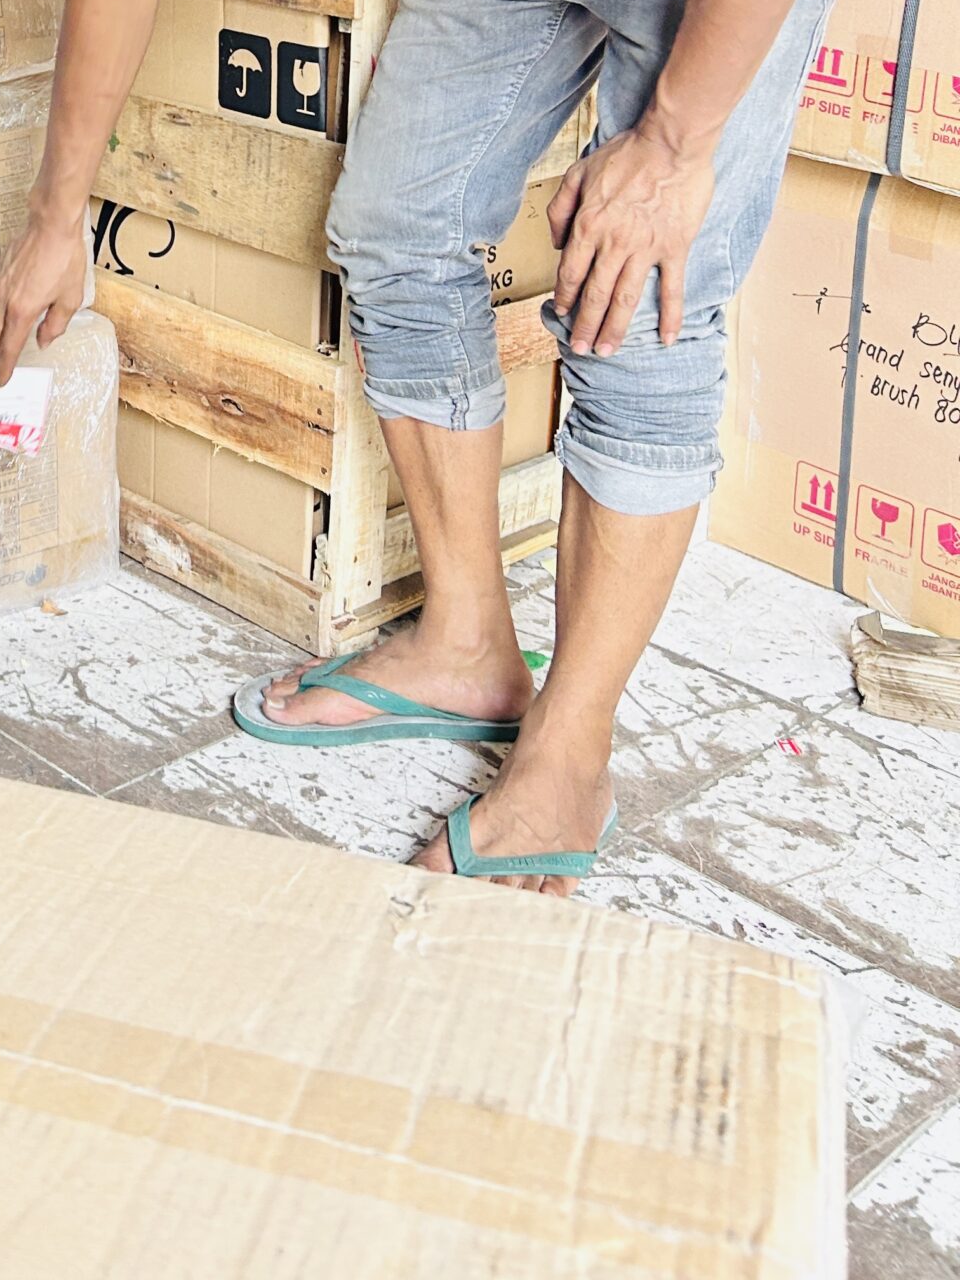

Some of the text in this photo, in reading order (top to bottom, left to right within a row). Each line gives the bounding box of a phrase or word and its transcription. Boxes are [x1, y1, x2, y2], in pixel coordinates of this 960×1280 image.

[818, 99, 851, 119] SIDE
[490, 269, 513, 291] KG
[870, 374, 920, 410] Brush
[793, 521, 835, 548] UP SID
